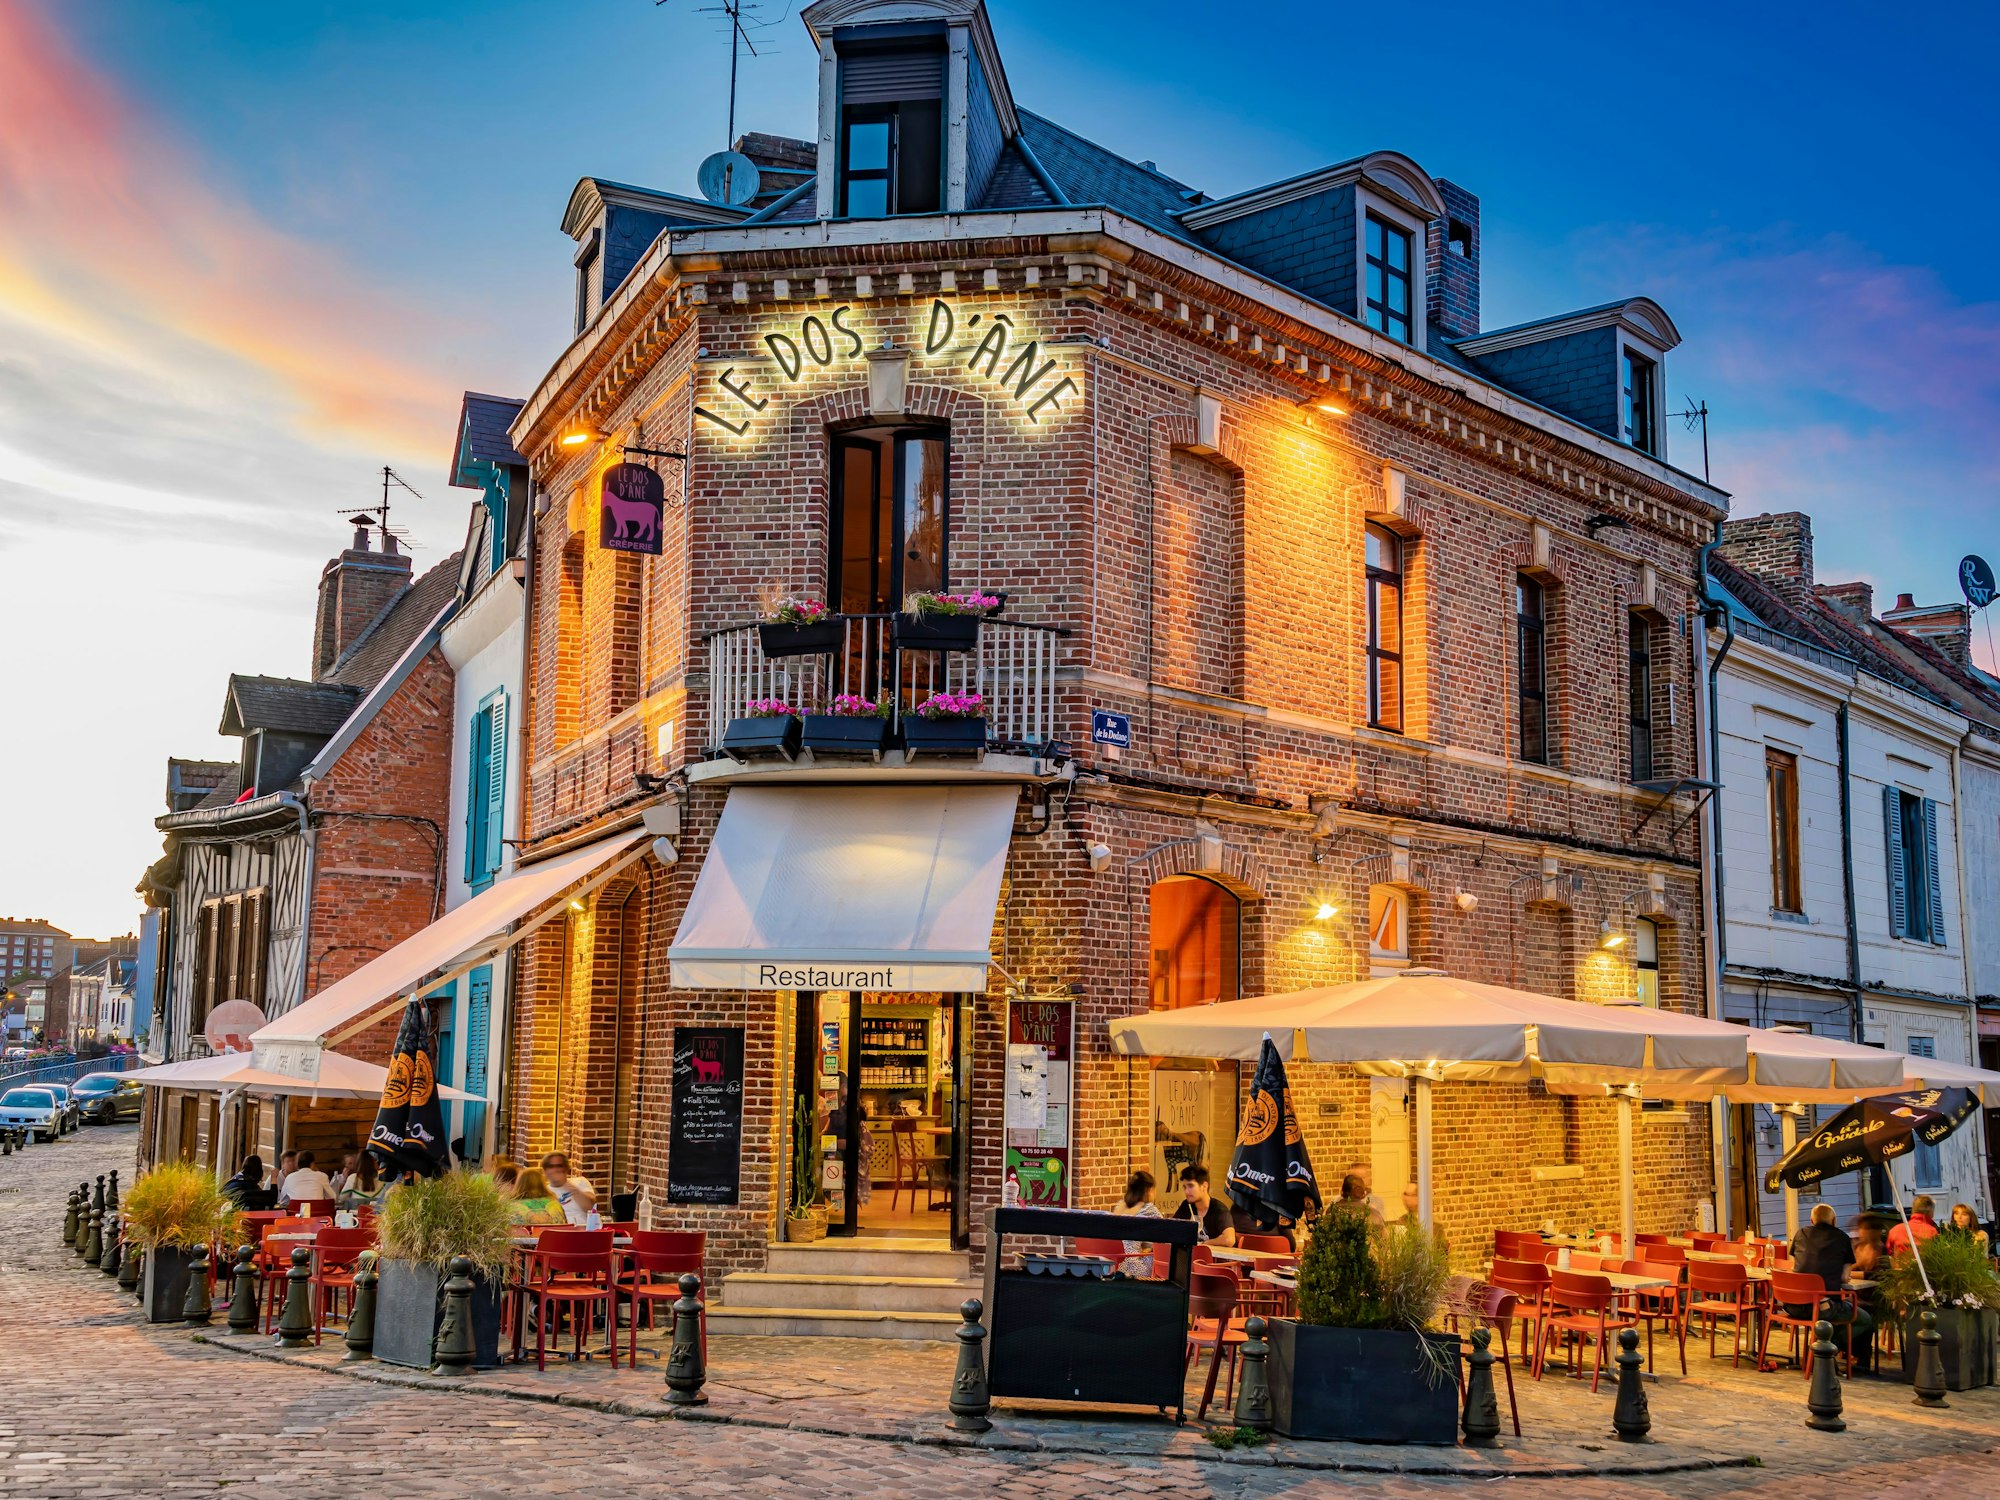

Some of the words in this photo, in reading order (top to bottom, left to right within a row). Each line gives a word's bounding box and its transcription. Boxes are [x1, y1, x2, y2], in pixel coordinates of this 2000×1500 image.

[694, 367, 769, 437] LE
[764, 305, 862, 382] DOS
[926, 299, 1080, 425] D'ÂNE
[618, 467, 629, 482] LE
[632, 469, 649, 485] DOS
[619, 482, 646, 500] D'ÂNE
[608, 539, 654, 551] CRÊPERIE
[1096, 728, 1102, 737] de
[1106, 718, 1117, 728] Rue
[760, 964, 893, 988] Restaurant
[1021, 1004, 1033, 1022] LE
[1039, 1004, 1060, 1023] DOS
[1023, 1021, 1056, 1042] D'ÂNE
[1168, 1080, 1178, 1102] LE
[1183, 1080, 1199, 1102] DOS
[1815, 1119, 1885, 1149] Goudale
[1236, 1162, 1276, 1184] Omer
